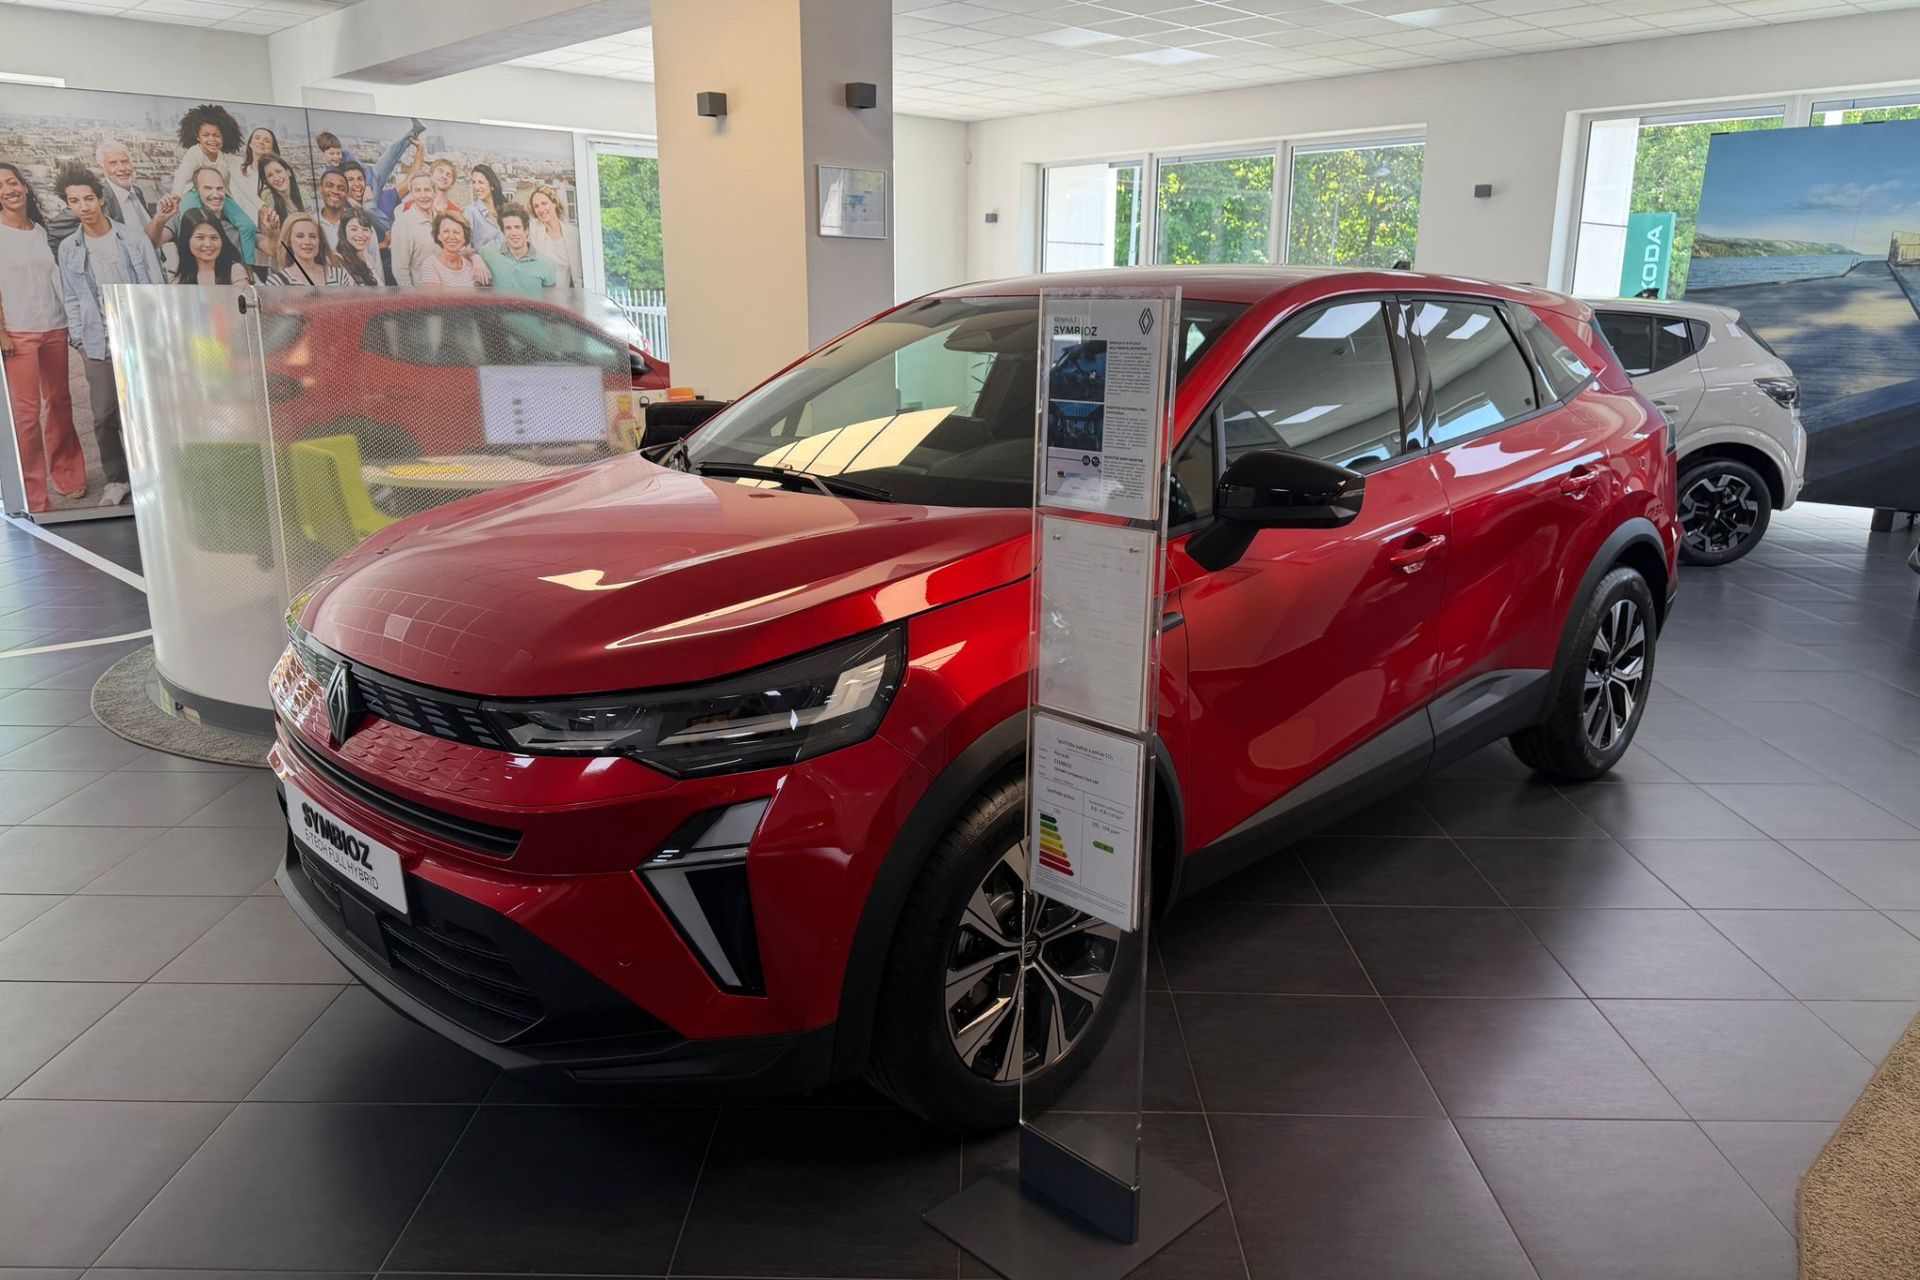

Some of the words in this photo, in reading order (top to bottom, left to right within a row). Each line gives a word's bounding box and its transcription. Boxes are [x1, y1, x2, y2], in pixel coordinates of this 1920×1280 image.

[1640, 224, 1663, 289] KODA
[301, 802, 373, 871] SYMBIOZ
[328, 847, 347, 870] FULL
[347, 859, 379, 890] HYBRID
